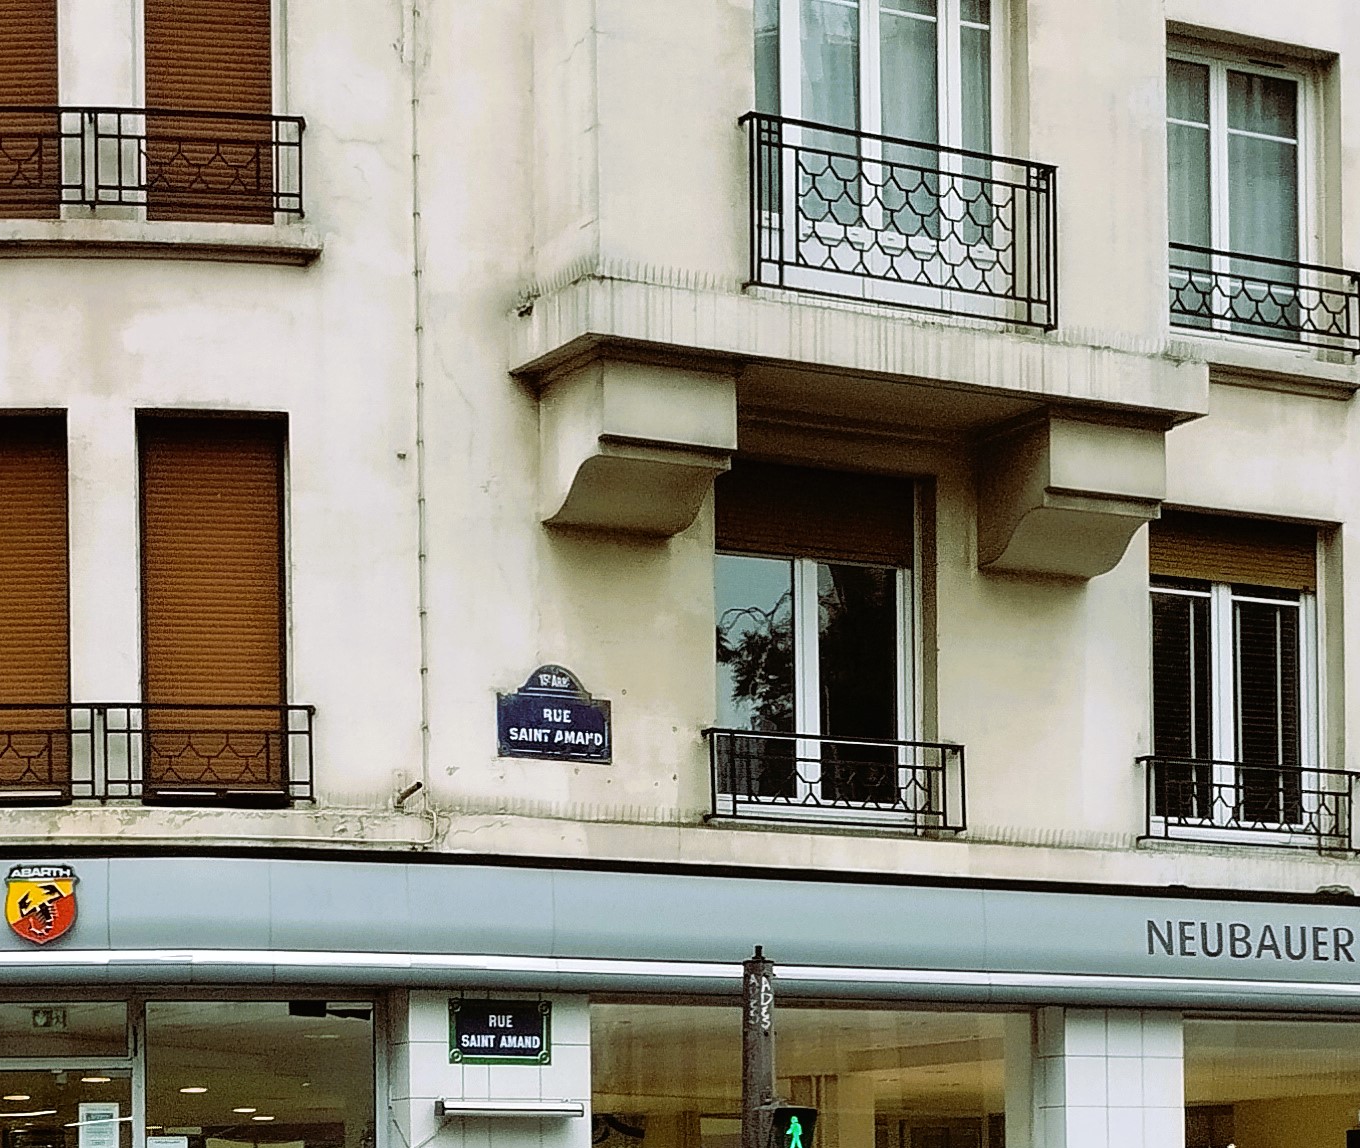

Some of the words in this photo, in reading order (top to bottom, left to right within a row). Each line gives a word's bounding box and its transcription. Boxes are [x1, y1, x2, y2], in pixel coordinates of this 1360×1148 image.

[543, 708, 572, 723] RUE
[509, 727, 551, 743] SAINT
[554, 730, 603, 746] AMAND
[11, 867, 71, 878] ABARTH
[1147, 919, 1356, 963] NEUBAUER
[488, 1014, 514, 1028] RUE
[461, 1034, 496, 1048] SAINT
[499, 1035, 540, 1049] AMAND
